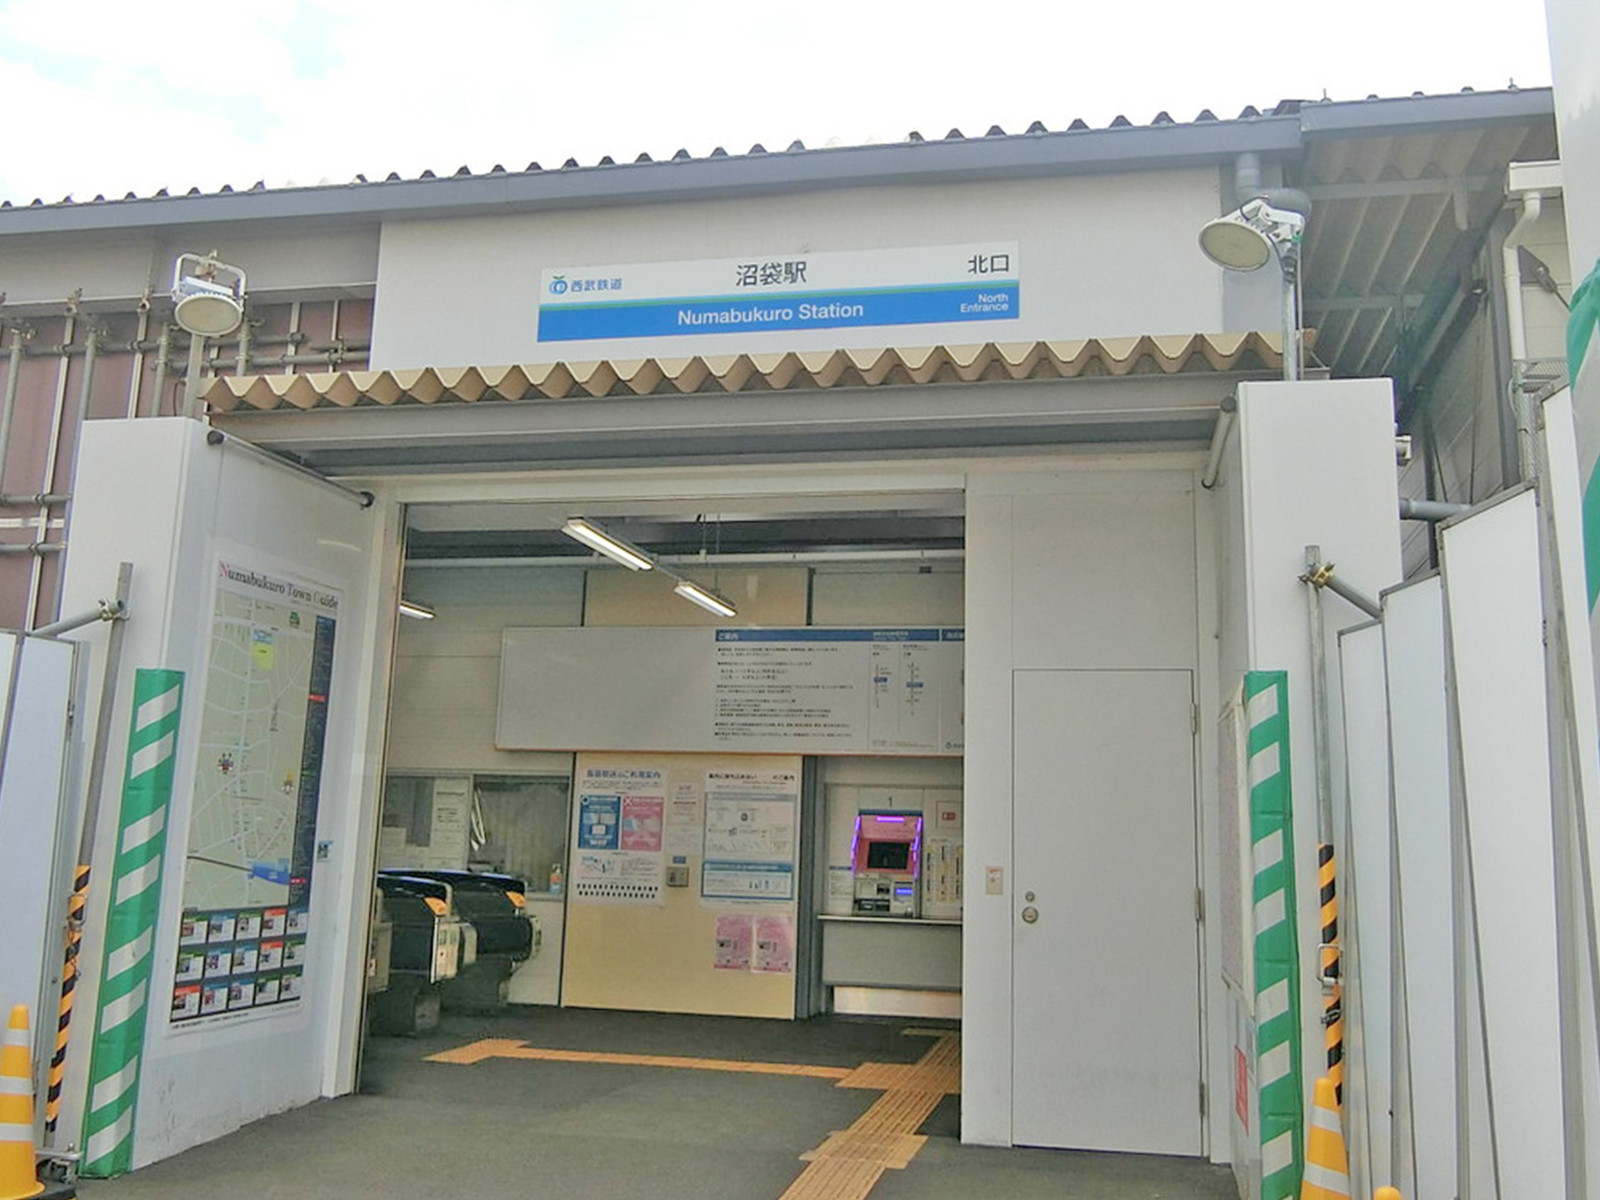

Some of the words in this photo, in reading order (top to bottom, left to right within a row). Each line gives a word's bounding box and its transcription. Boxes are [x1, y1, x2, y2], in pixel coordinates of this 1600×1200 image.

[735, 261, 807, 287] 沼袋駅
[967, 254, 1009, 274] 北口
[571, 278, 622, 293] 西武鉄道
[960, 302, 1009, 313] Entrance
[977, 293, 1009, 303] North
[677, 307, 793, 326] Numabukuro
[798, 302, 864, 321] Station
[219, 561, 285, 594] Numabukuro
[287, 583, 311, 602] Town
[313, 591, 338, 609] Guide
